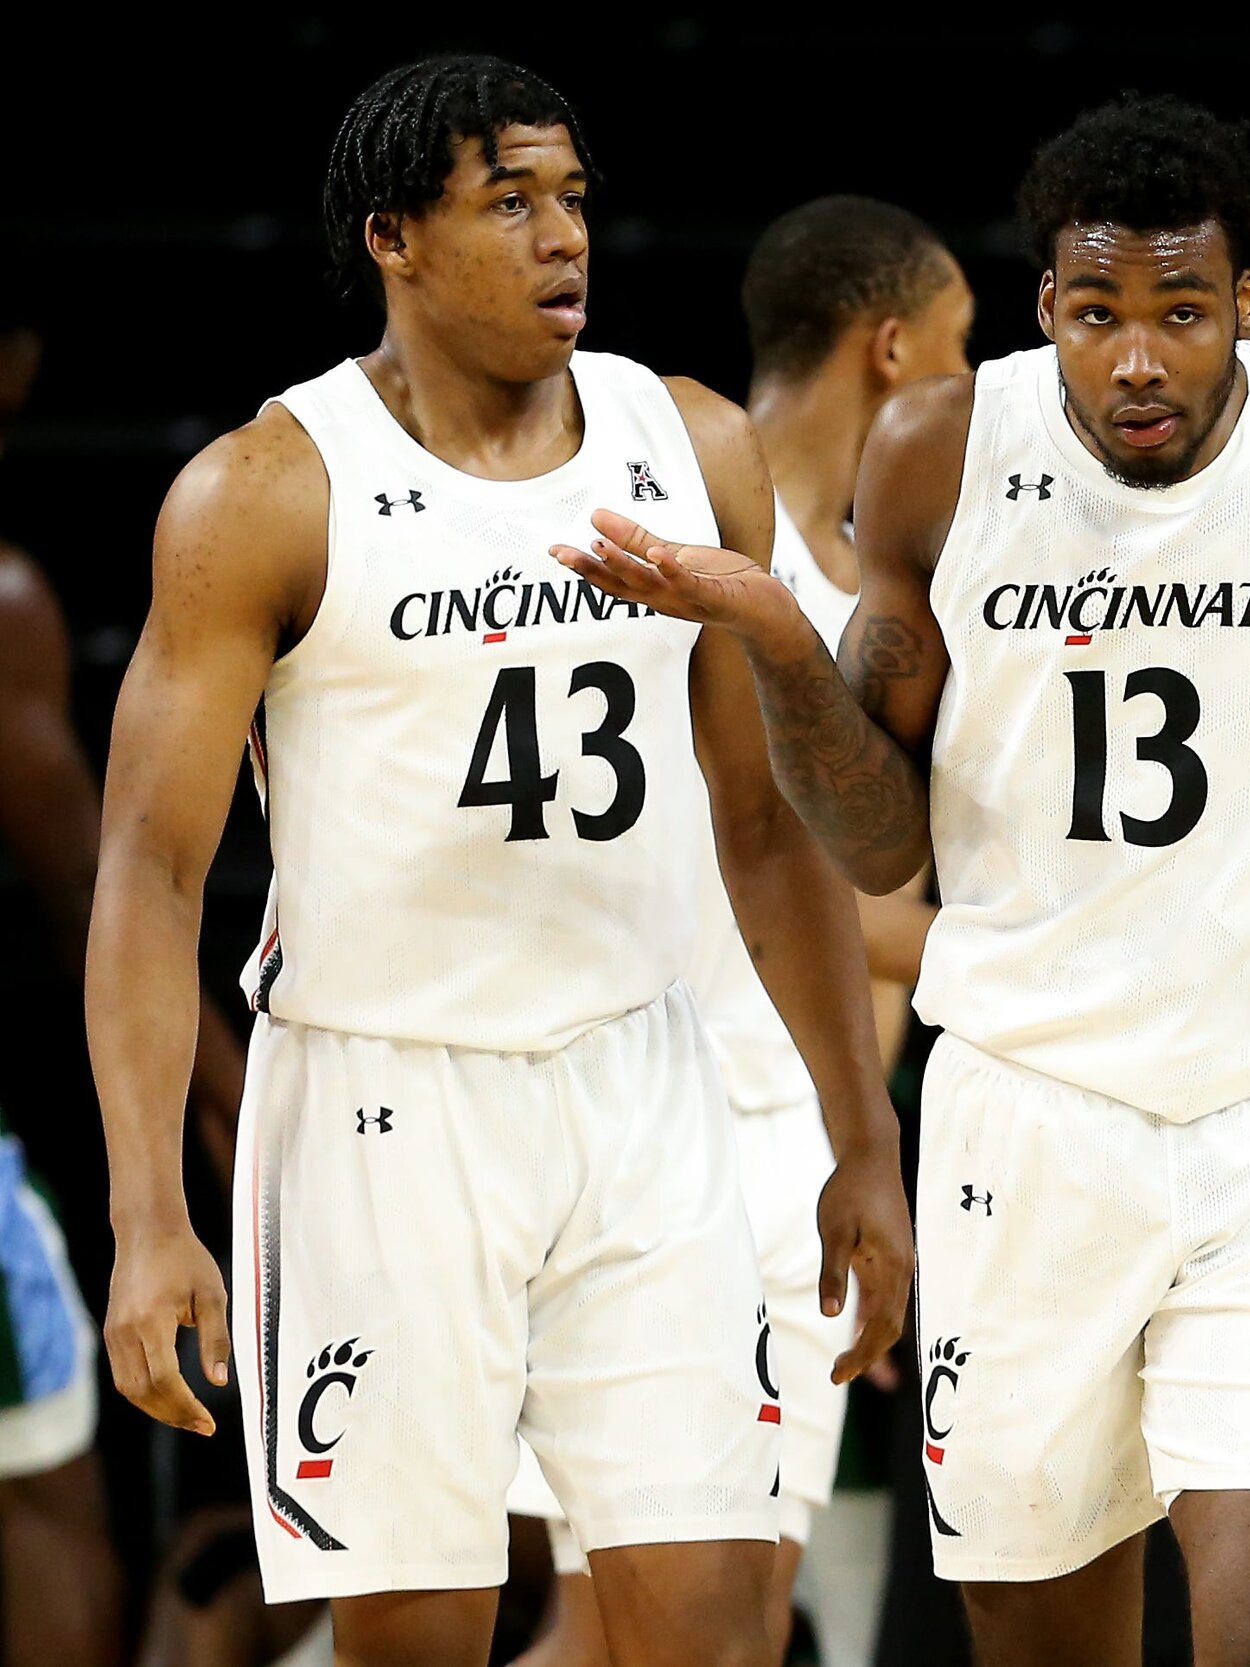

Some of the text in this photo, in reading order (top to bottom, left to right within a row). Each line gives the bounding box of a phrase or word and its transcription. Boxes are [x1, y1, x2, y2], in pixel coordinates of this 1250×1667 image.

[389, 578, 656, 641] CINCINNA
[456, 660, 647, 842] 43
[1062, 666, 1209, 848] 13
[297, 1371, 357, 1455] C
